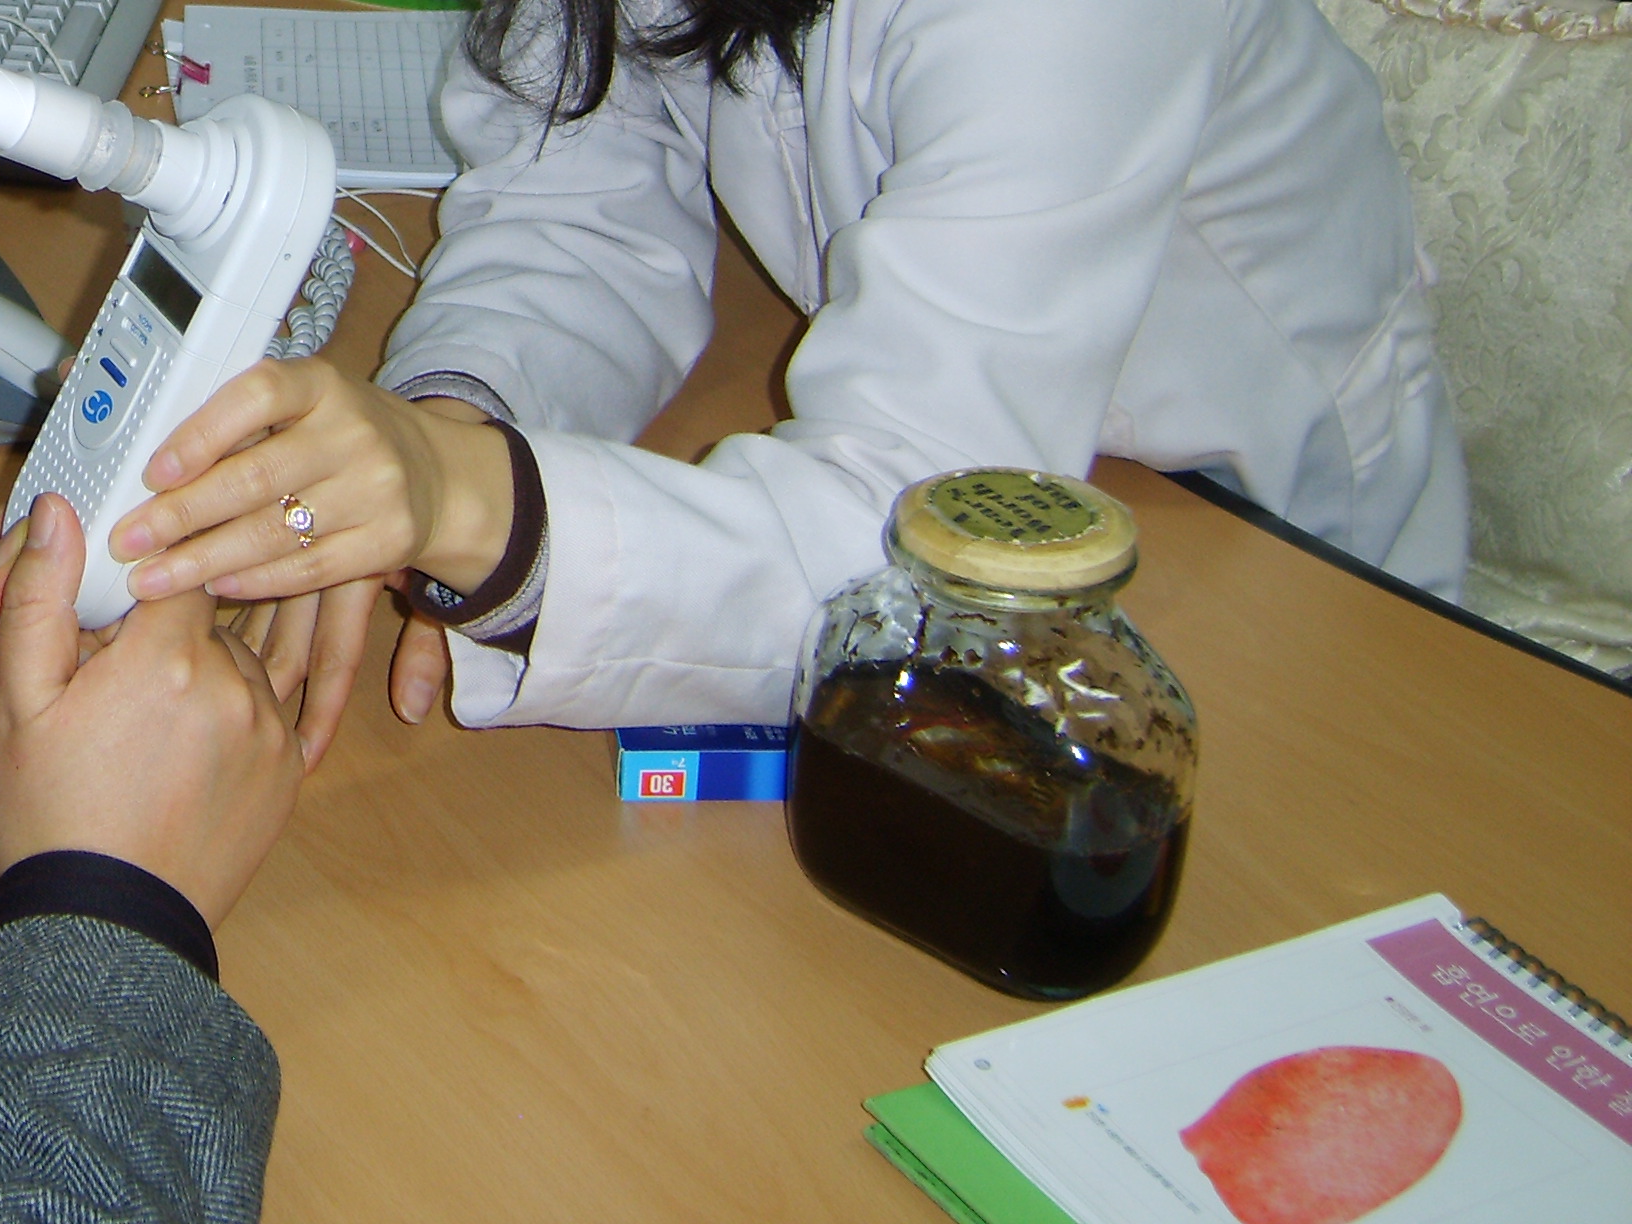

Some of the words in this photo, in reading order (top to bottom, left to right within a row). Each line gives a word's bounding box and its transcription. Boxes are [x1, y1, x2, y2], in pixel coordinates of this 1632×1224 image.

[650, 774, 674, 794] 30
[1431, 964, 1549, 1046] 흡연으로
[1545, 1045, 1614, 1091] 인한
